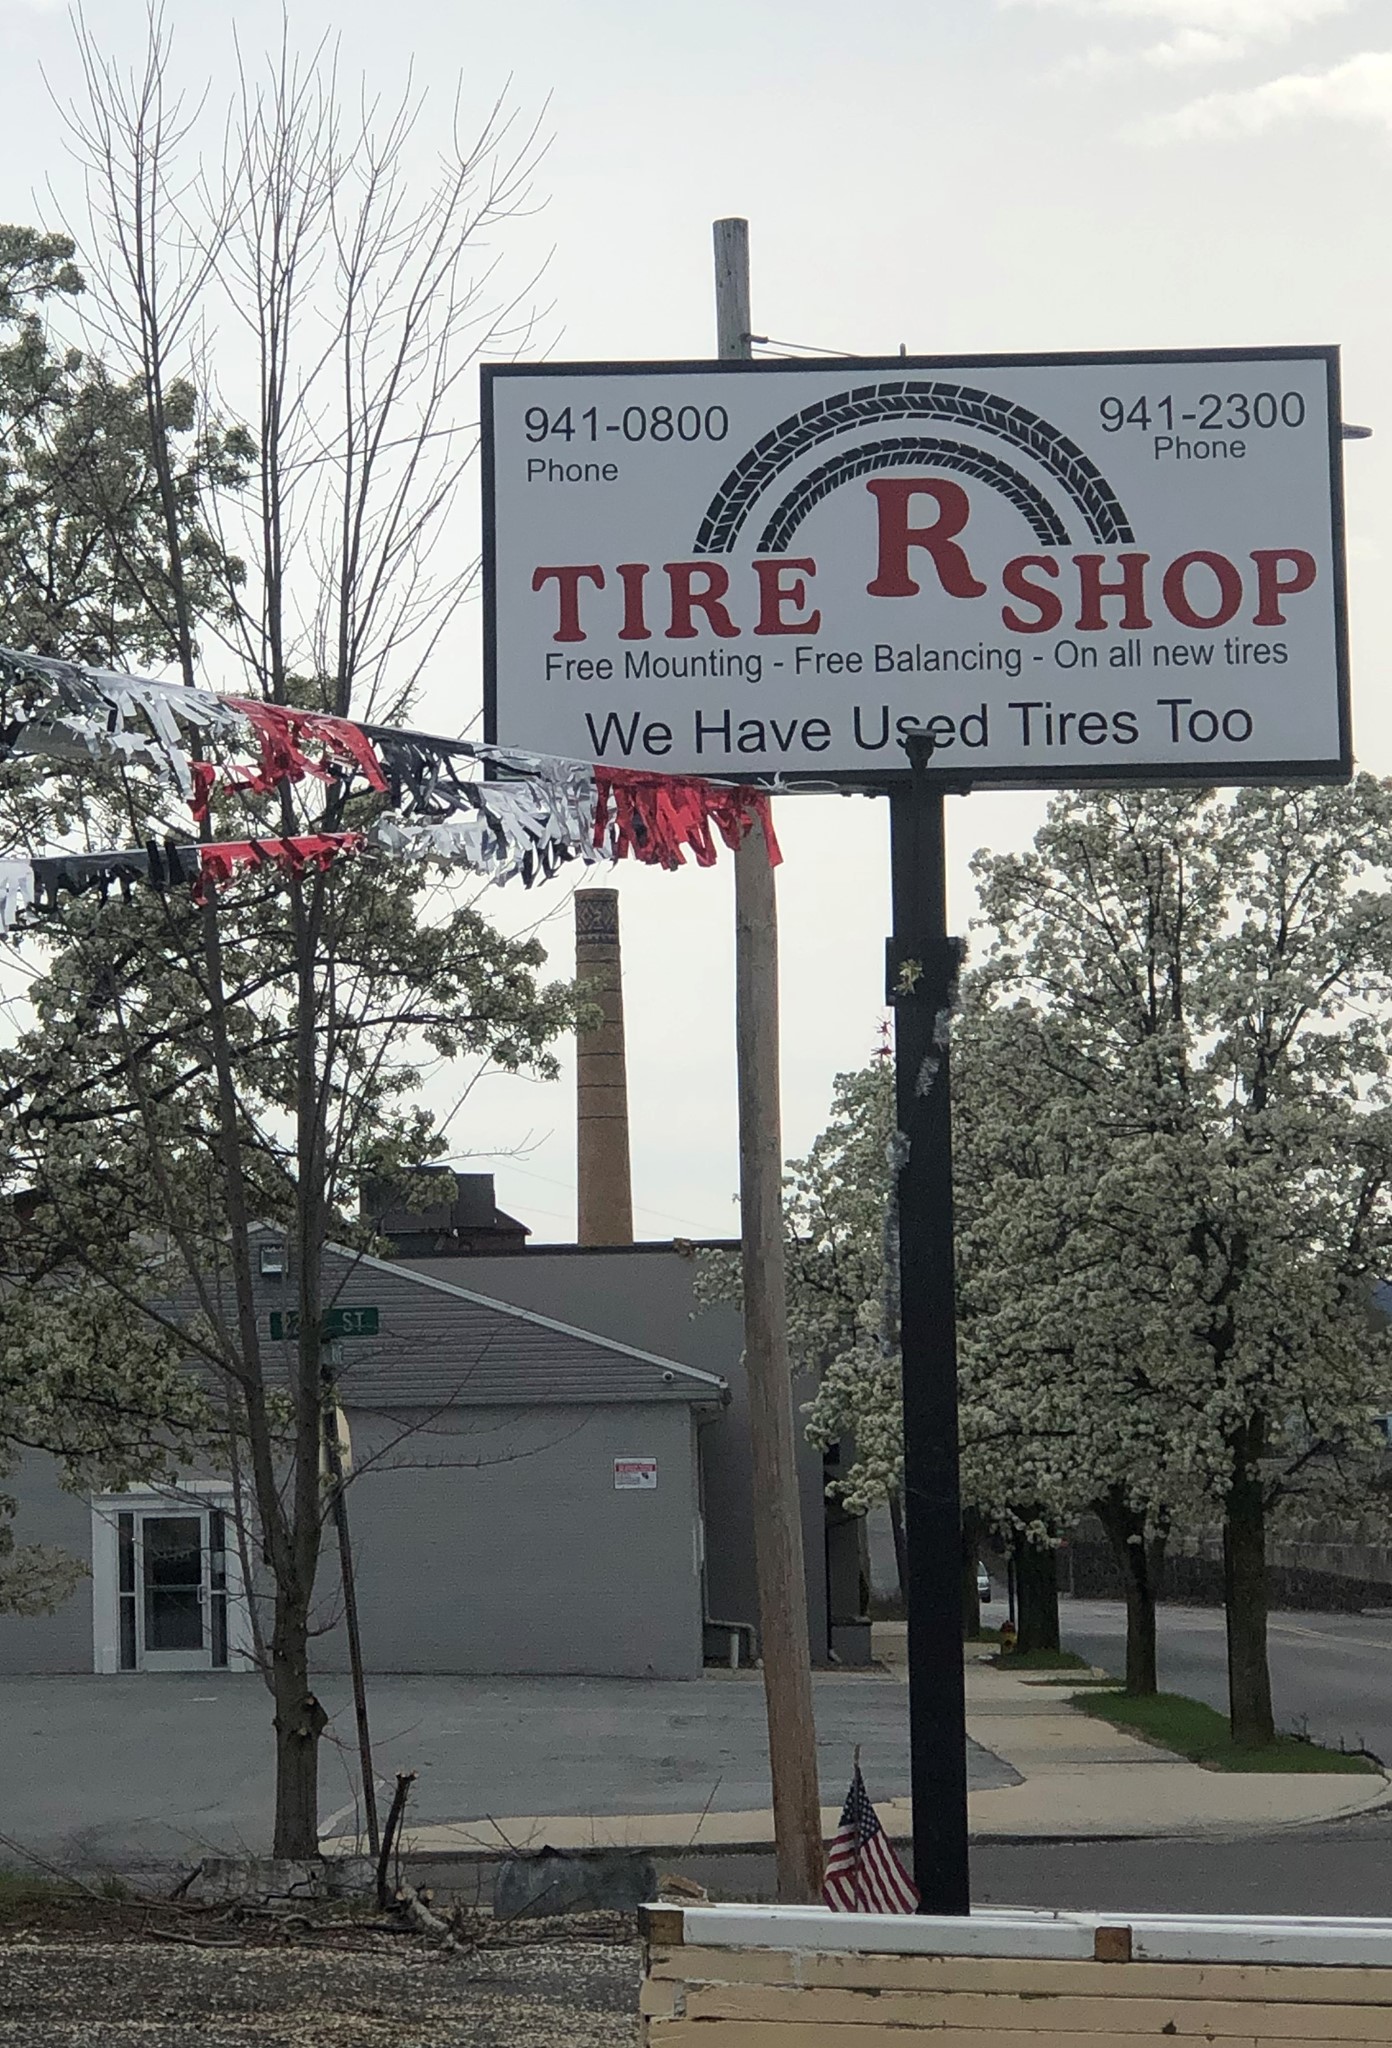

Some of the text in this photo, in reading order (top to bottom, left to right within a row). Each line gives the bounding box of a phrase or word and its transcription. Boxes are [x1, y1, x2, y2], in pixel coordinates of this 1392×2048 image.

[525, 406, 728, 442] 941-0800
[1100, 392, 1304, 432] 941-2300
[1155, 436, 1245, 459] Phone
[528, 459, 618, 482] Phone
[532, 477, 1316, 641] TIRE R SHOP
[546, 653, 612, 680] Free
[625, 650, 761, 683] Mounting
[796, 647, 862, 674] Free
[875, 642, 1021, 677] Balancing
[1055, 640, 1097, 668] On
[1110, 639, 1140, 667] all
[1154, 645, 1214, 666] new
[1224, 639, 1287, 665] tires
[585, 712, 672, 756] We
[696, 709, 831, 754] Have
[1008, 702, 1138, 746] Tires
[1157, 699, 1252, 742] Too
[342, 1311, 364, 1332] ST
